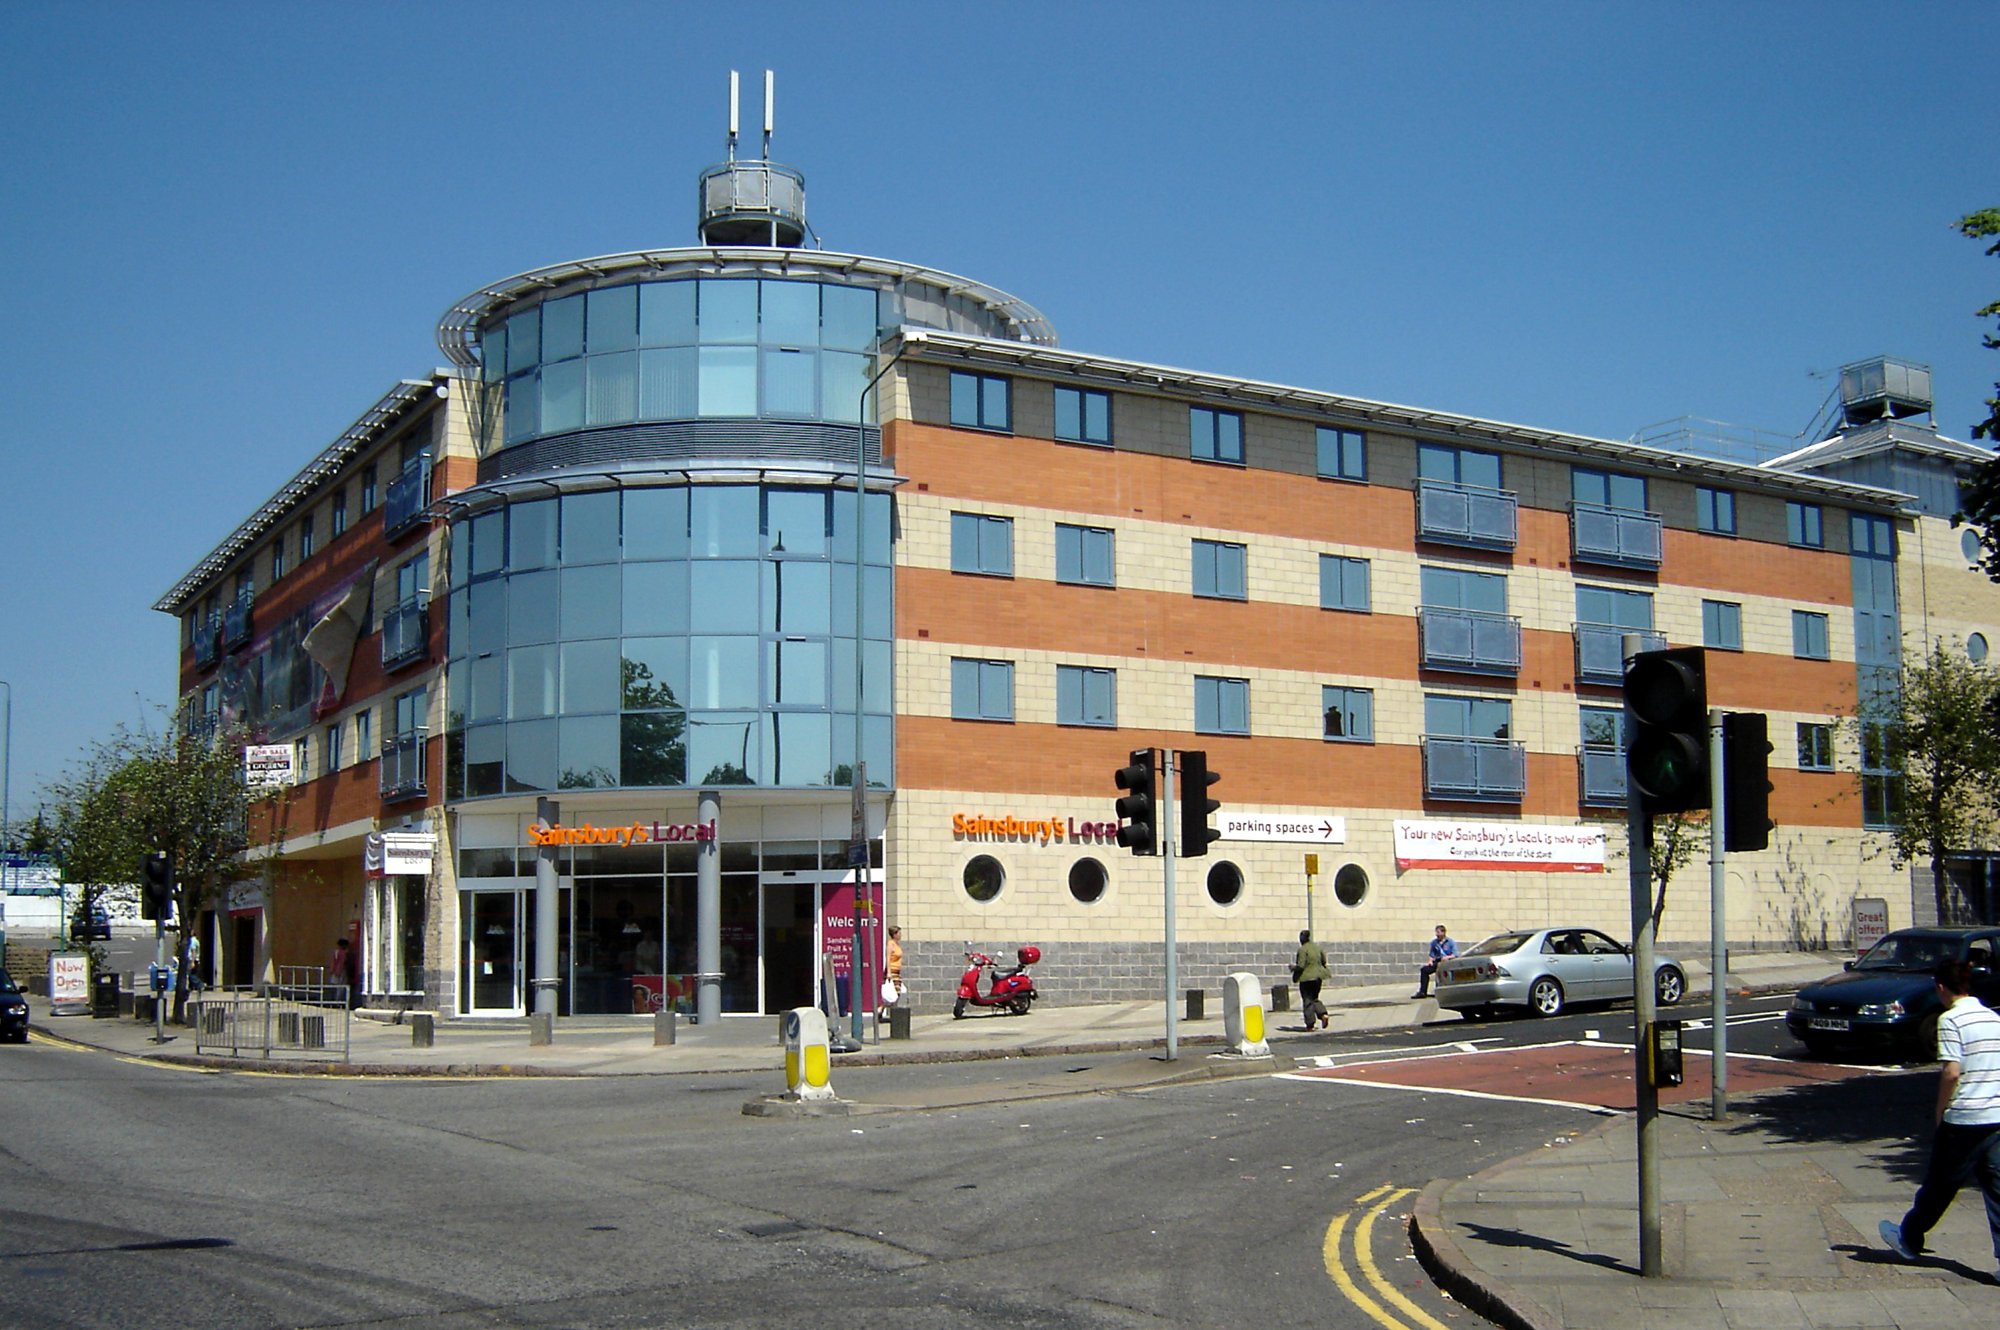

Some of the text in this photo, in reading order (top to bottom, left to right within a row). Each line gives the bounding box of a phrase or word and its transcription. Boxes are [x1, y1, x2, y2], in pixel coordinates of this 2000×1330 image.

[527, 818, 717, 848] Sainsbury's Local
[953, 813, 1065, 842] Sainsbury's
[1228, 820, 1315, 836] parking spaces
[1401, 825, 1428, 840] Your
[1431, 830, 1453, 841] new
[1455, 827, 1513, 847] Sainsbury's
[1544, 833, 1553, 845] is
[1554, 834, 1575, 844] now
[1577, 836, 1598, 849] open
[1450, 846, 1463, 855] Car
[1464, 847, 1478, 859] park
[1488, 848, 1500, 858] the
[1524, 849, 1535, 859] the
[827, 916, 879, 928] Welcme
[1857, 911, 1884, 922] Great
[1856, 924, 1885, 935] offers
[56, 960, 84, 973] Now
[56, 975, 85, 991] Open
